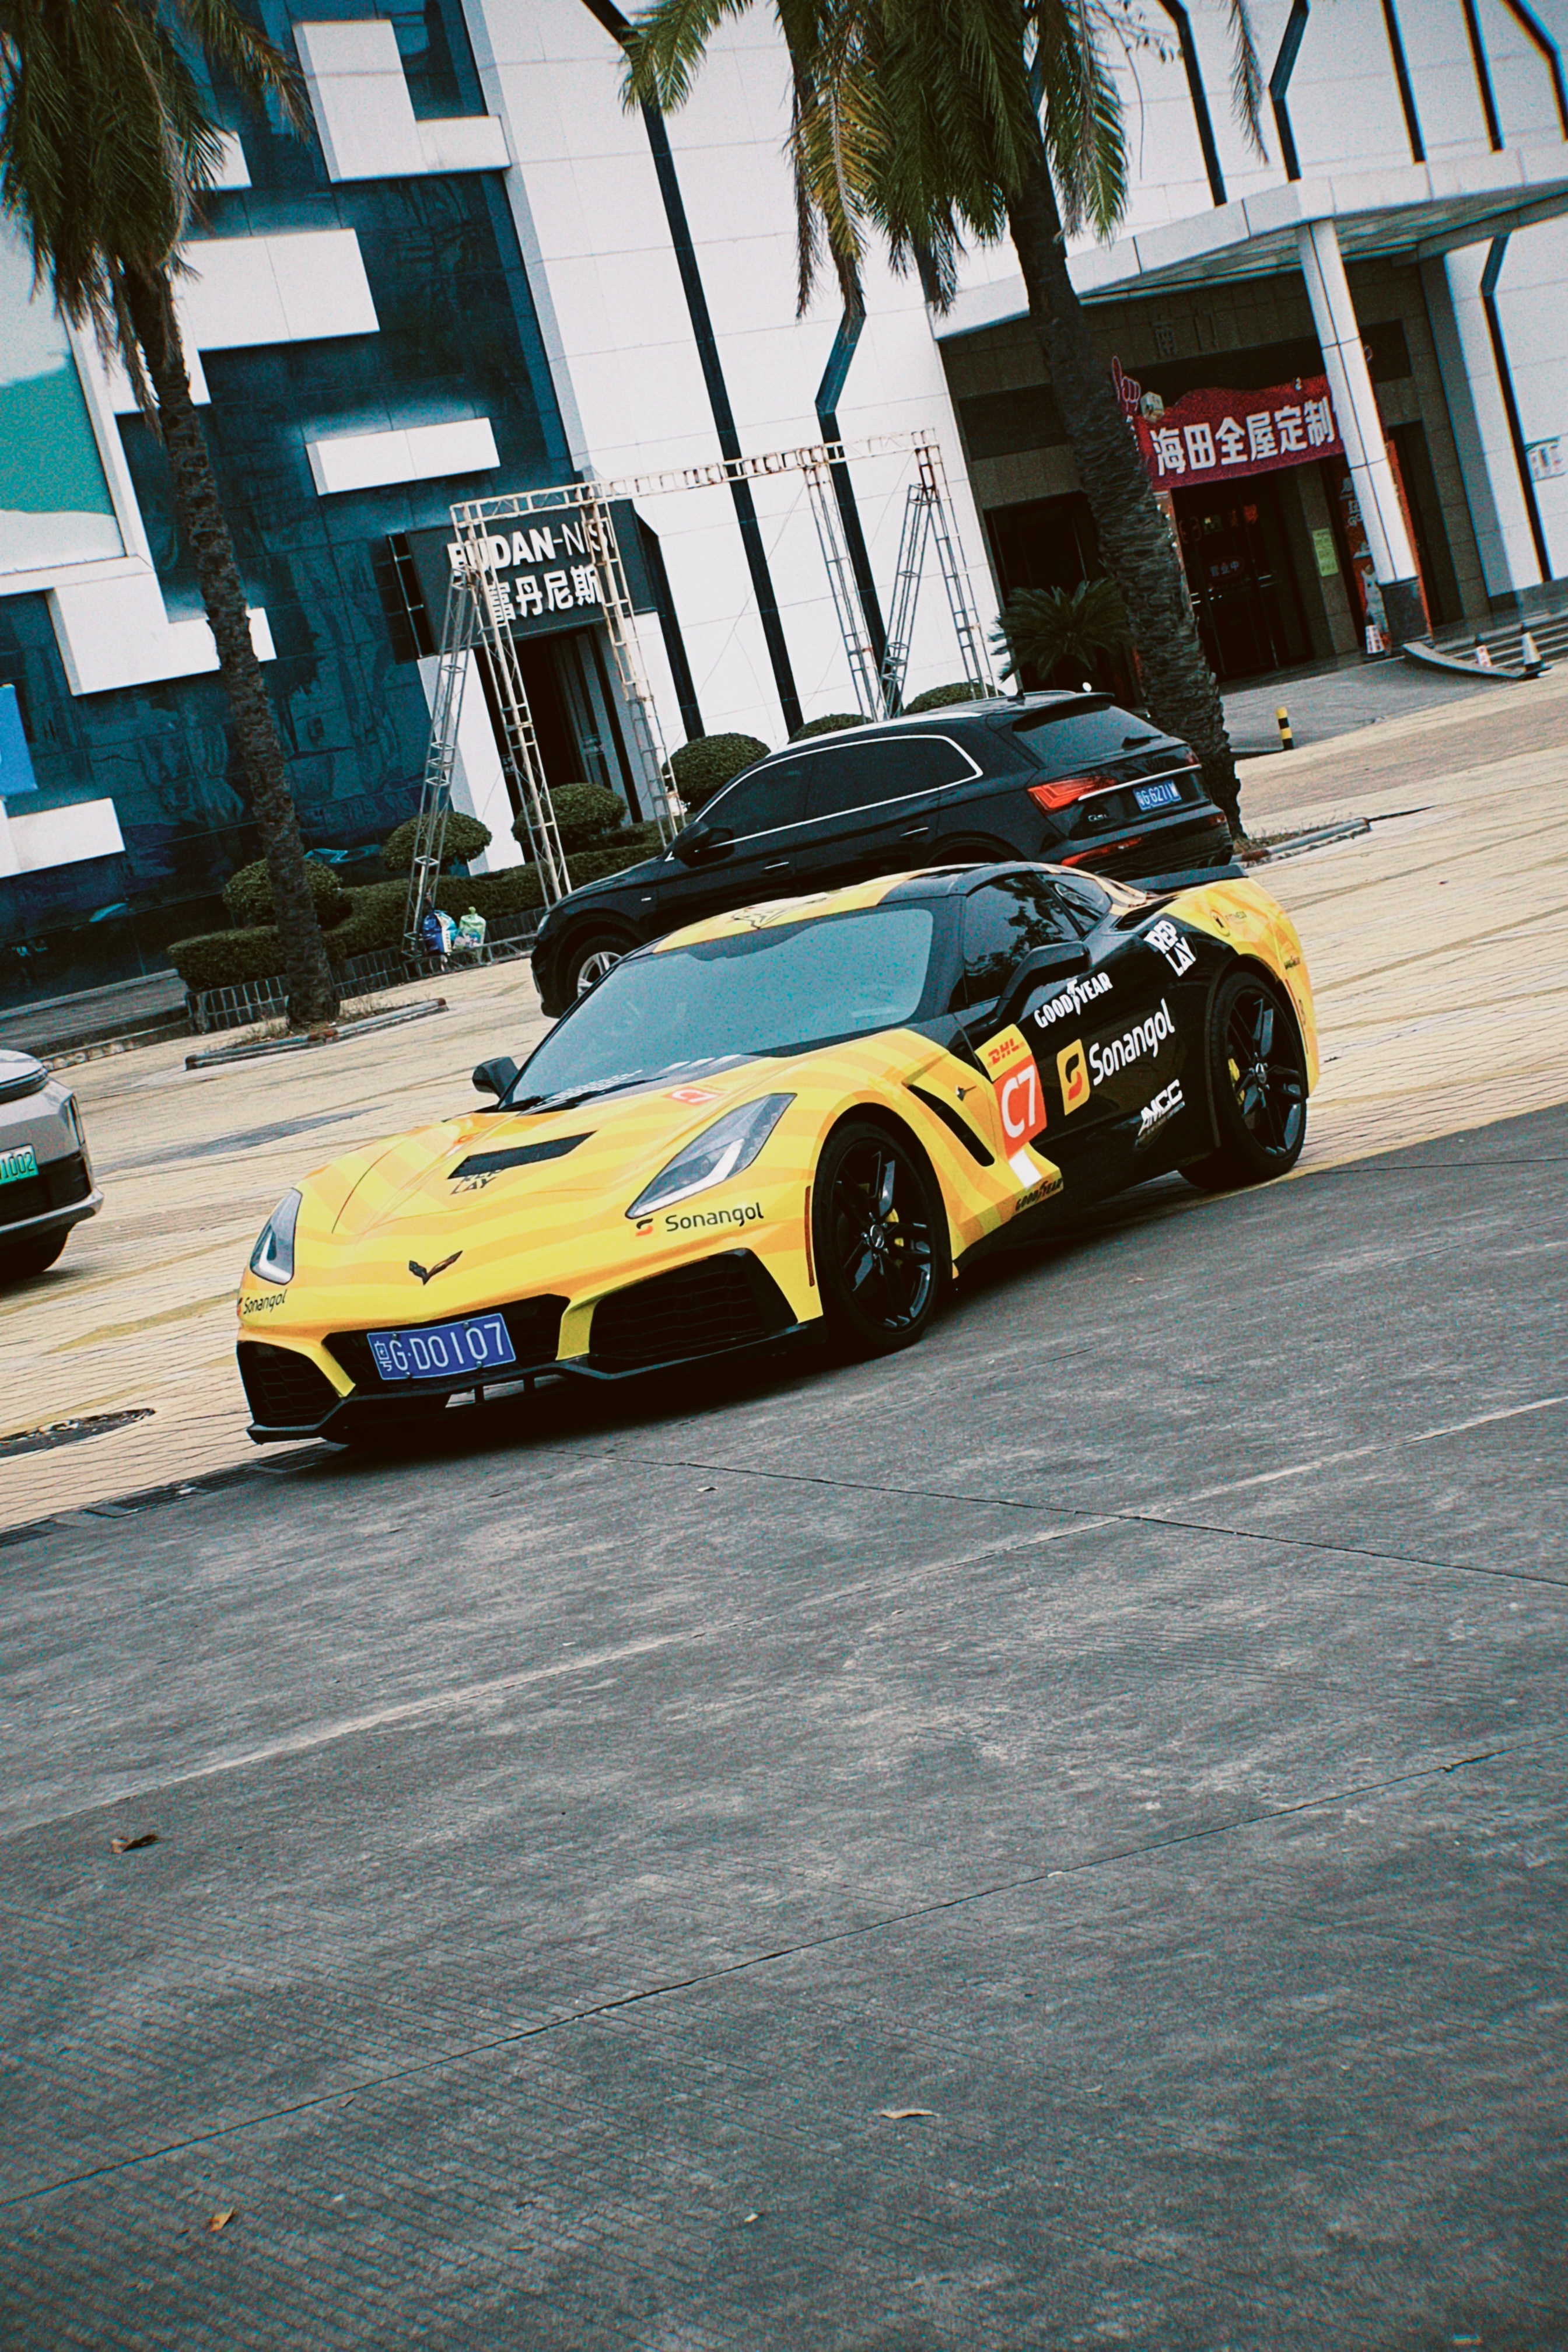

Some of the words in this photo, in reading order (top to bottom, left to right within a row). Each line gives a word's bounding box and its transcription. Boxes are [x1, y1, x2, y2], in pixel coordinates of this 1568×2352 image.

[1149, 396, 1335, 476] 海田全屋定制
[1143, 919, 1179, 954] REP
[1165, 936, 1196, 977] LAY
[988, 1038, 1021, 1065] DHL
[1088, 998, 1175, 1086] Sonangol
[1001, 1064, 1035, 1138] C7
[0, 1151, 36, 1180] 1002
[664, 1202, 764, 1232] Sonangol
[243, 1288, 288, 1315] Sonangol
